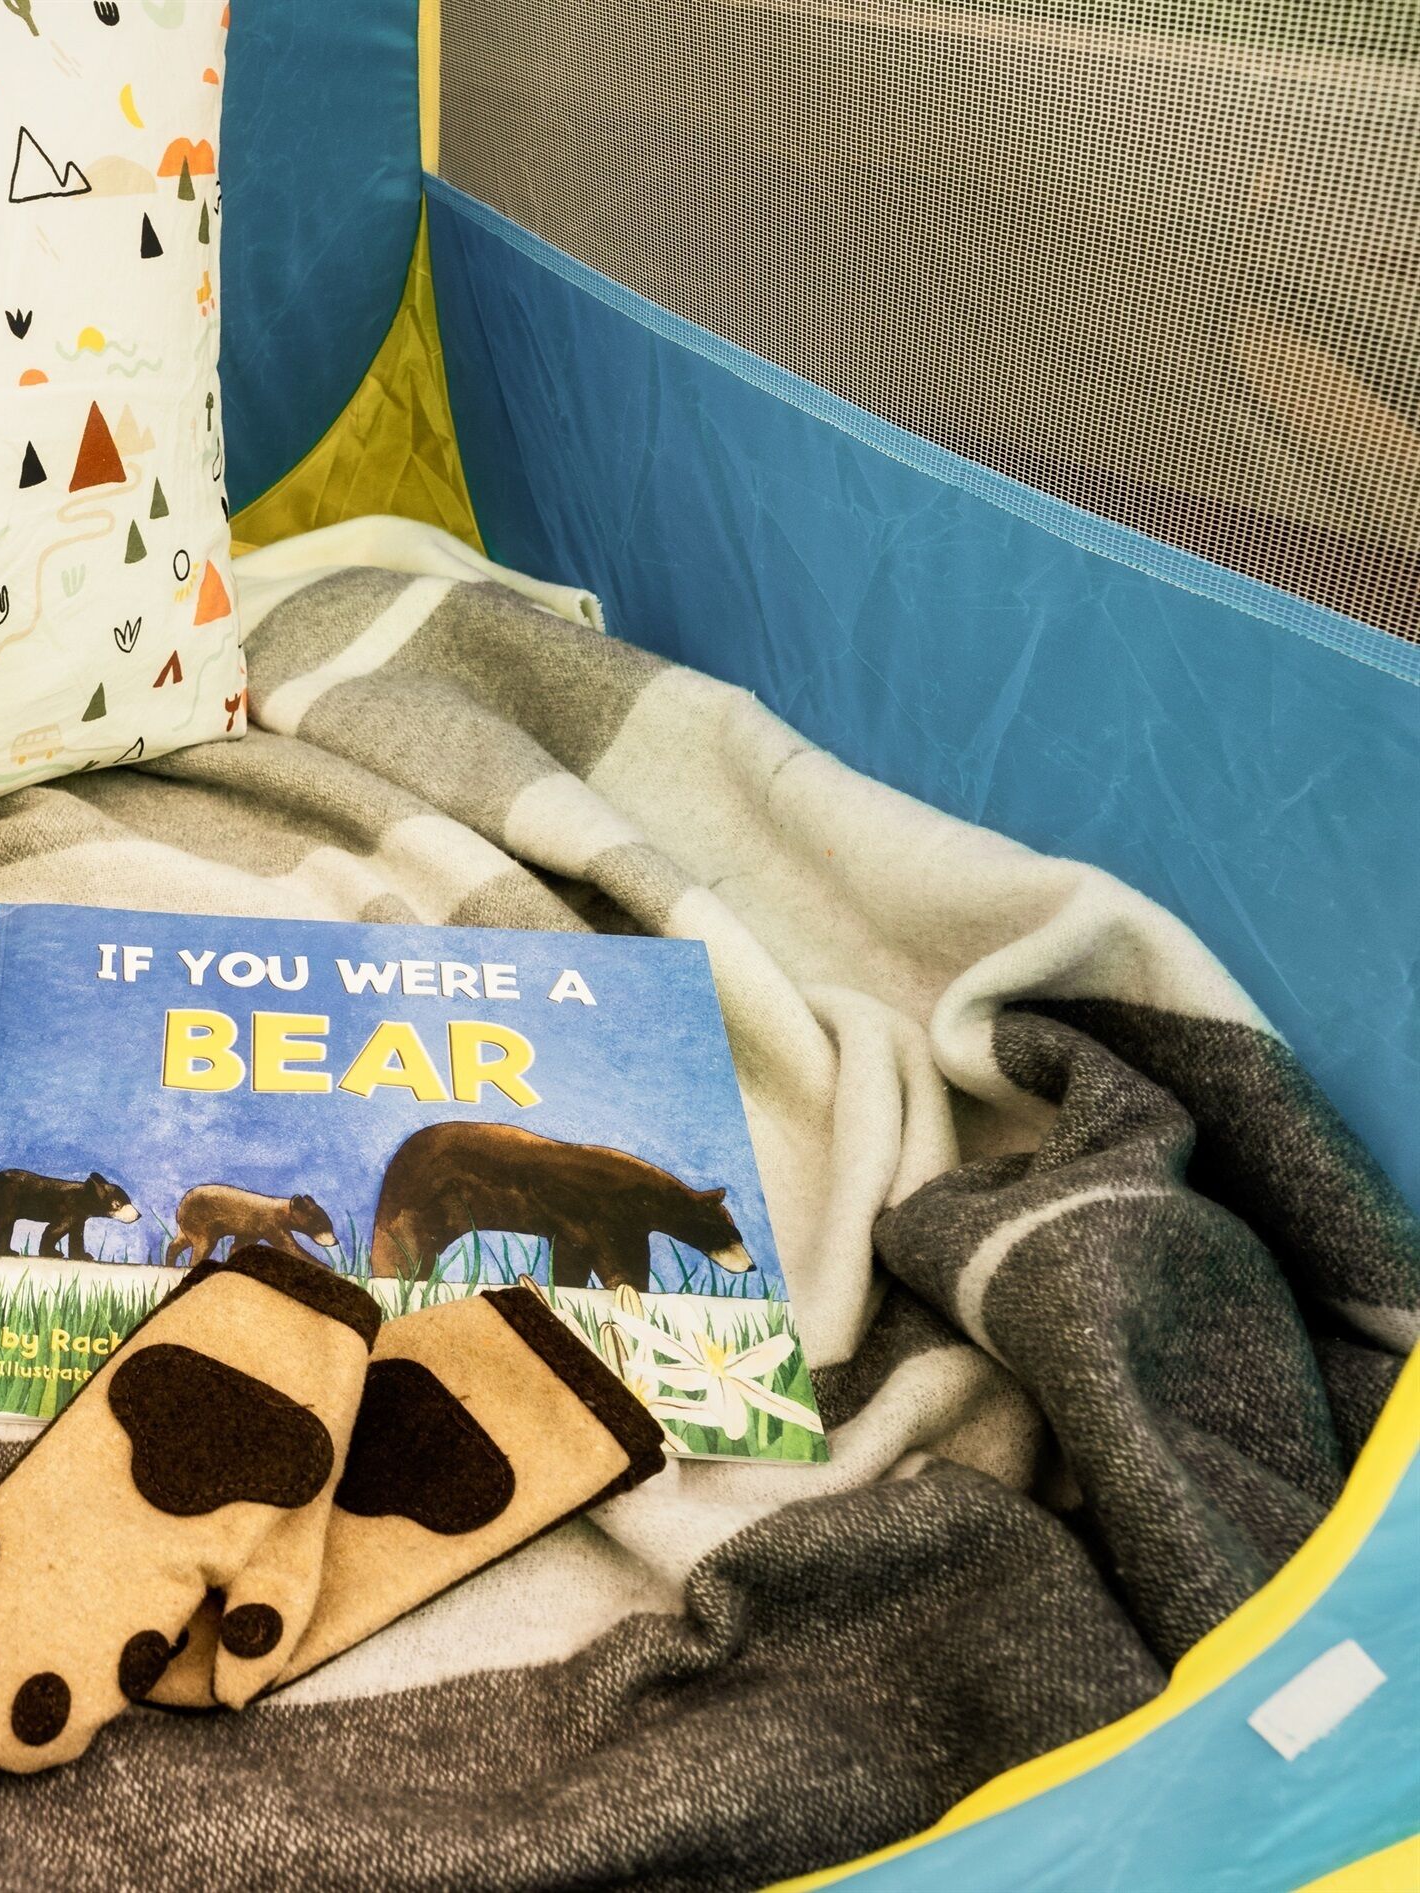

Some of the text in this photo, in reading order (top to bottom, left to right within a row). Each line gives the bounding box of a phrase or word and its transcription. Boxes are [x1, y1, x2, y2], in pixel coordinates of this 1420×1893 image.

[97, 943, 598, 1006] IF YOU WERE A
[161, 1008, 543, 1109] BEAR
[1, 1326, 39, 1359] by
